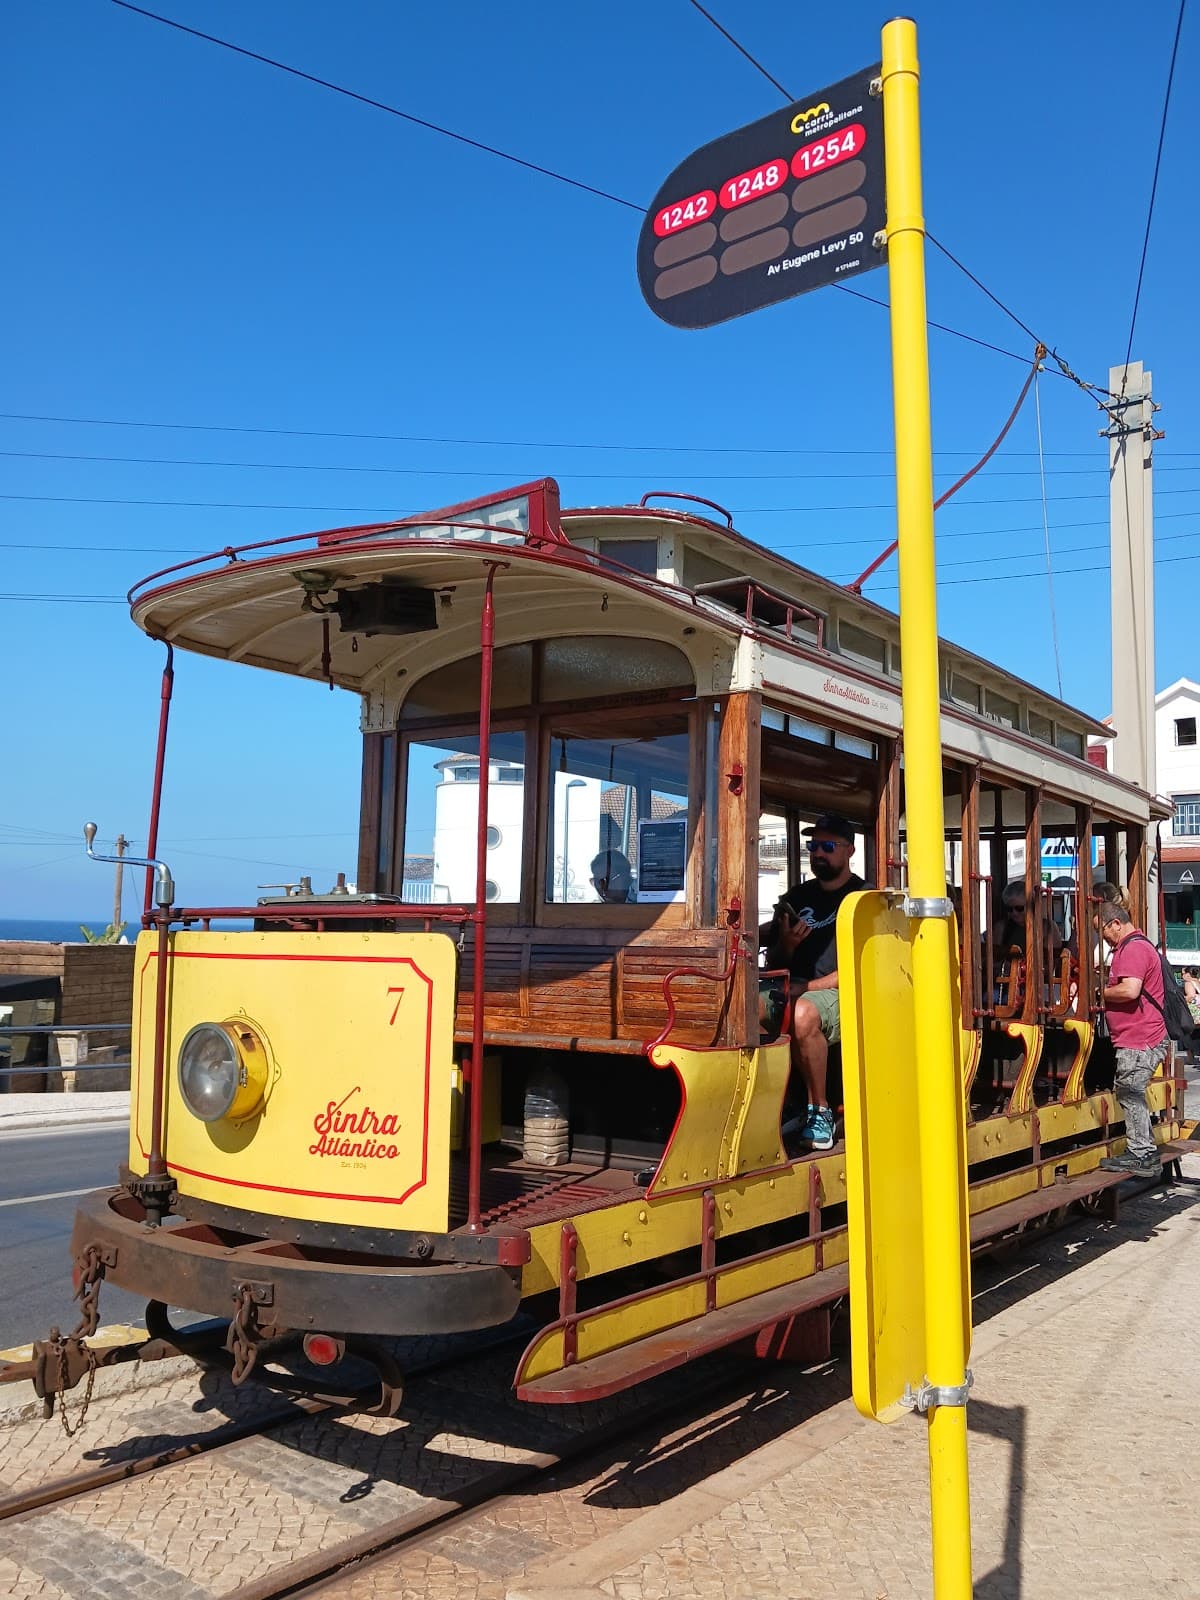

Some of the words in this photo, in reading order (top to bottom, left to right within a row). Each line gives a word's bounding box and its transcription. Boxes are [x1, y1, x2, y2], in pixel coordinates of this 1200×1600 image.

[804, 111, 834, 129] carris
[805, 105, 863, 137] metropolitana
[661, 196, 708, 230] 1242
[727, 165, 779, 202] 1248
[800, 131, 856, 171] 1254
[767, 263, 780, 276] Av
[782, 249, 820, 271] Eugene
[821, 238, 847, 256] Levy
[849, 231, 864, 245] 50
[386, 986, 405, 1026] 7
[313, 1087, 401, 1135] Sintra
[309, 1130, 400, 1159] Atlântico
